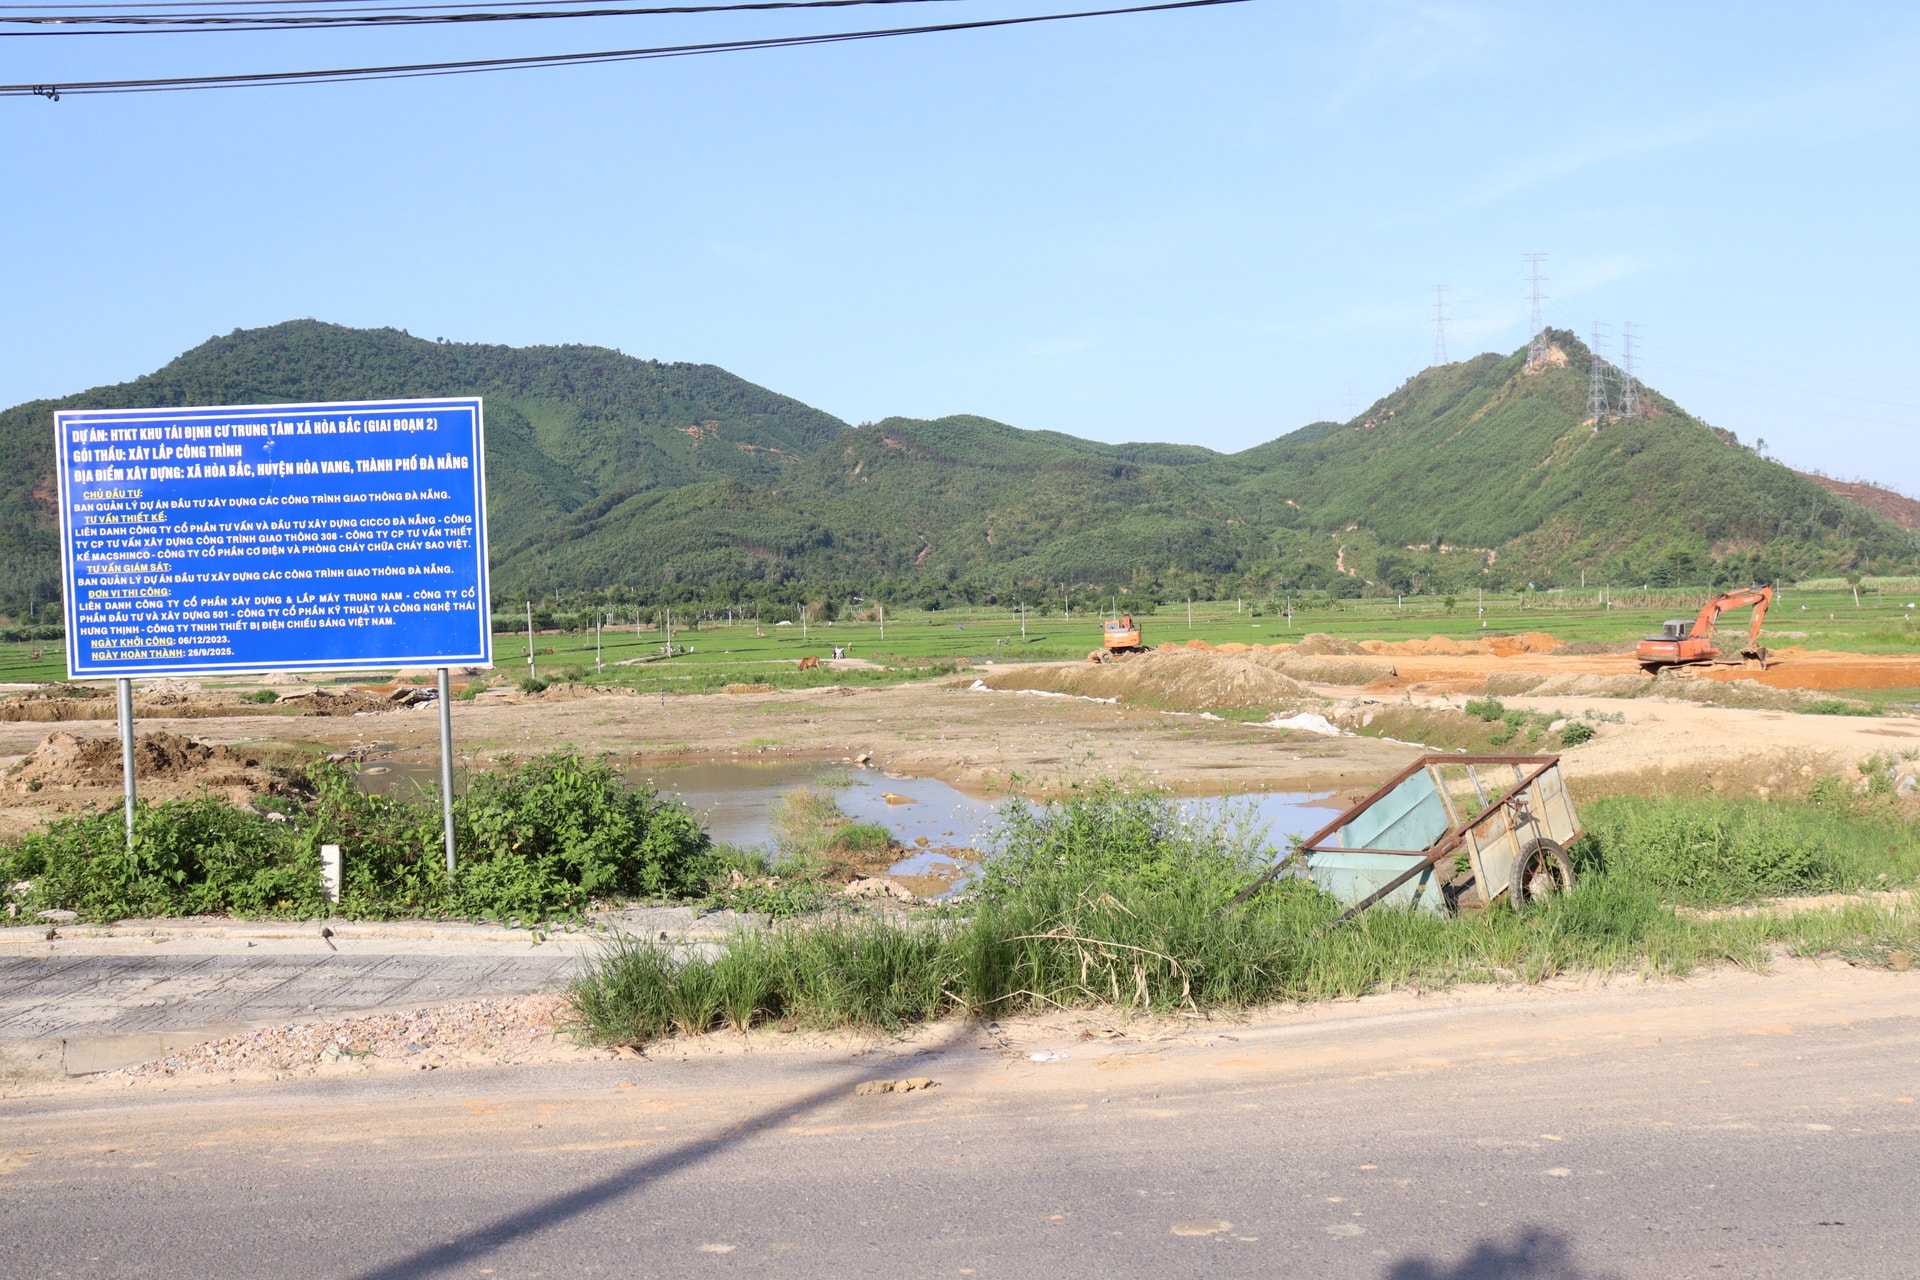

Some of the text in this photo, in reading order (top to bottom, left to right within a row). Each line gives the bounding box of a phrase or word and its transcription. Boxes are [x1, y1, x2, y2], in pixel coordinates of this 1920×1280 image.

[72, 428, 88, 445] DỰ
[89, 427, 108, 442] ÁN:
[110, 428, 138, 441] HTKT
[139, 427, 162, 440] KHU
[164, 424, 182, 439] TÁI
[184, 425, 212, 441] ĐỊNH
[214, 424, 230, 438] CƯ
[230, 423, 268, 437] TRUNG
[270, 420, 294, 436] TÂM
[296, 420, 312, 435] XÃ
[313, 418, 337, 434] HÒA
[363, 419, 391, 434] (GIAI
[393, 418, 424, 433] ĐOẠN
[426, 417, 438, 431] 2)
[73, 447, 92, 463] GÓI
[128, 445, 150, 461] XÂY
[175, 444, 207, 459] CÔNG
[208, 442, 242, 458] TRÌNH
[73, 469, 94, 485] ĐỊA
[126, 465, 148, 481] XÂY
[150, 466, 184, 482] DỰNG:
[186, 463, 202, 478] XÃ
[203, 462, 227, 478] HÒA
[296, 459, 319, 474] HÒA
[320, 460, 354, 474] VANG,
[355, 457, 393, 472] THÀNH
[395, 454, 418, 471] PHỐ
[419, 455, 435, 470] ĐÀ
[73, 503, 94, 512] BAN
[96, 500, 123, 511] QUẢN
[125, 500, 137, 510] LÝ
[140, 500, 154, 510] DỰ
[155, 499, 169, 509] ÁN
[192, 499, 206, 508] TƯ
[207, 497, 227, 507] XÂY
[229, 497, 257, 507] DỰNG
[259, 495, 279, 506] CÁC
[281, 495, 309, 505] CÔNG
[311, 493, 341, 503] TRÌNH
[343, 493, 367, 502] GIAO
[368, 491, 403, 501] THÔNG
[404, 490, 418, 500] ĐÀ
[82, 488, 104, 500] CHỦ
[75, 526, 97, 537] LIÊN
[99, 527, 127, 536] DANH
[129, 525, 157, 535] CÔNG
[219, 523, 232, 532] TƯ
[255, 520, 269, 530] VÀ
[293, 520, 306, 529] TƯ
[308, 518, 327, 529] XÂY
[329, 519, 357, 528] DỰNG
[359, 518, 391, 527] CICCO
[392, 516, 406, 526] ĐÀ
[444, 514, 472, 524] CÔNG
[84, 515, 98, 525] TƯ
[91, 551, 150, 561] MACSHINCO
[157, 549, 185, 559] CÔNG
[187, 549, 199, 557] TY
[246, 546, 260, 556] CƠ
[287, 544, 300, 554] VÀ
[302, 543, 336, 554] PHÒNG
[338, 542, 365, 552] CHÁY
[396, 540, 423, 550] CHÁY
[425, 541, 445, 549] SAO
[86, 564, 101, 574] TƯ
[123, 562, 149, 573] GIÁM
[79, 601, 101, 611] LIÊN
[105, 601, 131, 610] DANH
[135, 599, 163, 609] CÔNG
[231, 596, 250, 606] XÂY
[254, 596, 282, 606] DỰNG
[319, 593, 340, 602] MÁY
[343, 593, 377, 602] TRUNG
[381, 592, 402, 600] NAM
[413, 589, 441, 600] CÔNG
[445, 590, 457, 598] TY
[88, 589, 109, 599] ĐƠN
[110, 589, 121, 598] VỊ
[121, 589, 139, 598] THI
[130, 612, 144, 621] TƯ
[145, 611, 159, 621] VÀ
[161, 610, 180, 620] XÂY
[182, 611, 210, 620] DỰNG
[212, 610, 228, 619] 501
[237, 608, 265, 618] CÔNG
[267, 608, 280, 616] TY
[343, 604, 375, 615] THUẬT
[377, 603, 391, 613] VÀ
[393, 602, 421, 612] CÔNG
[452, 600, 475, 610] THÁI
[80, 626, 108, 635] HƯNG
[109, 626, 139, 635] THỊNH
[146, 623, 175, 633] CÔNG
[176, 624, 189, 632] TY
[190, 623, 217, 632] TNHH
[250, 622, 260, 631] BỊ
[318, 617, 346, 627] SÁNG
[91, 637, 118, 648] NGÀY
[91, 650, 119, 661] NGÀY
[120, 649, 148, 660] HOÀN
